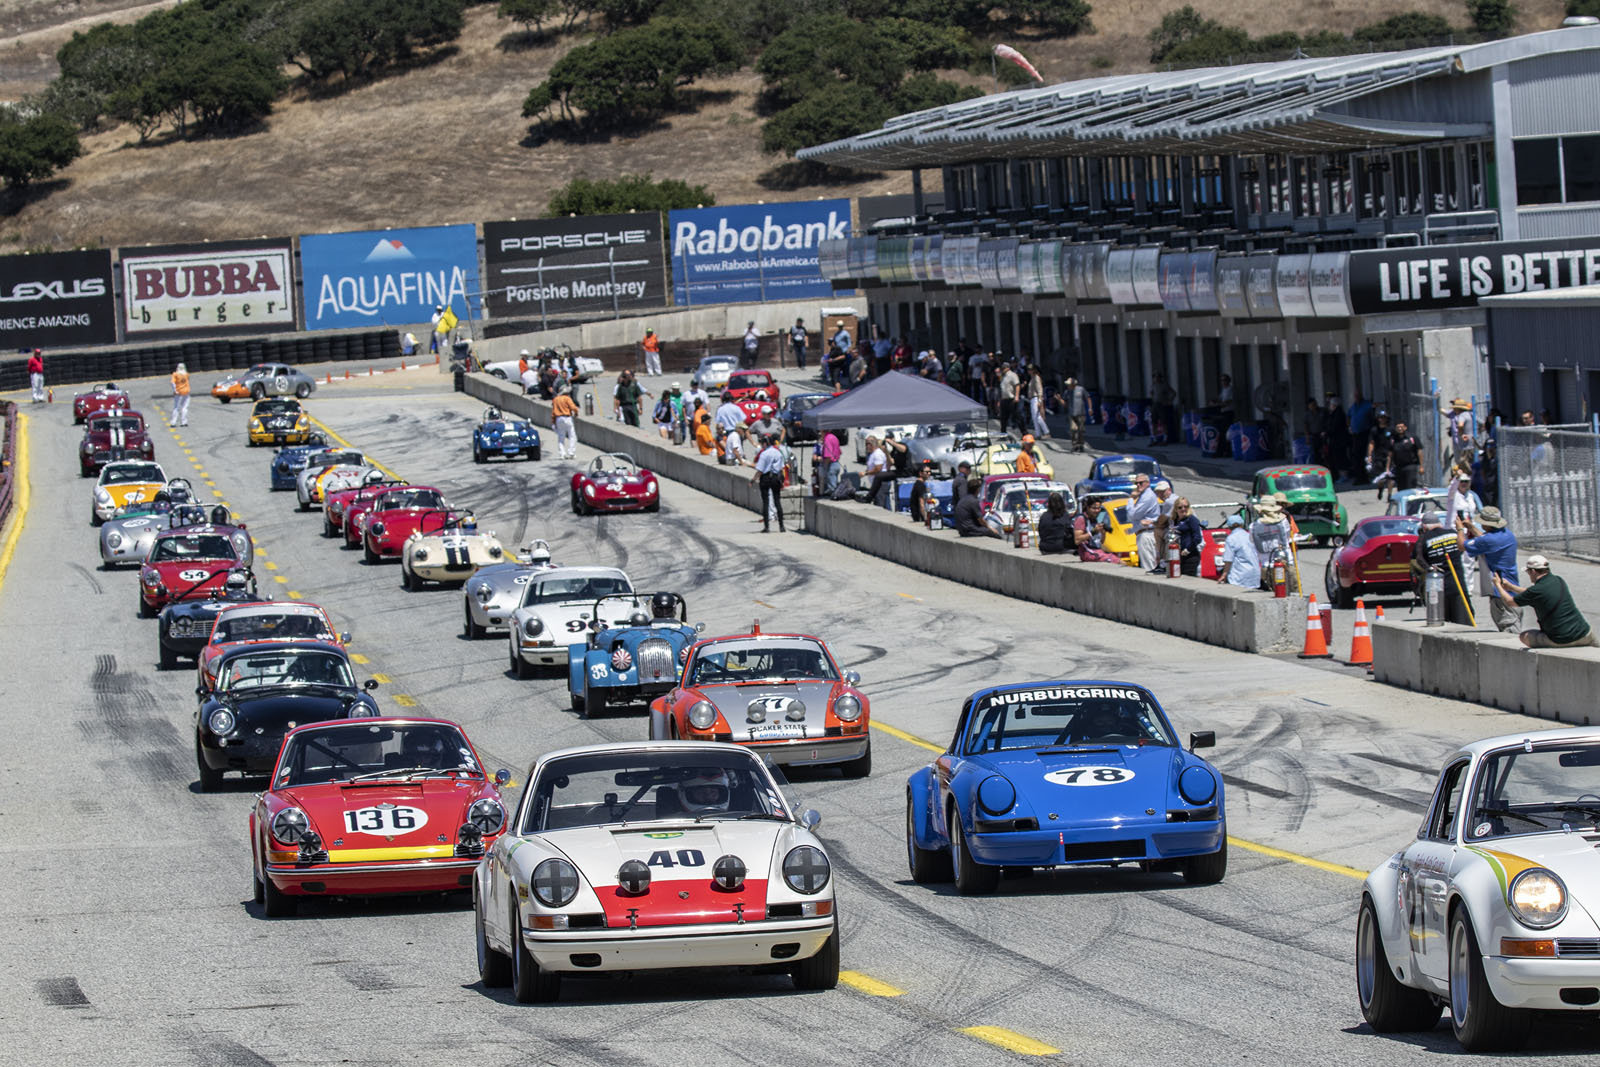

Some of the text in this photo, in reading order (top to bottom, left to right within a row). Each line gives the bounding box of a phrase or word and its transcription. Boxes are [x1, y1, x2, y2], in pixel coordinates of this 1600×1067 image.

[501, 230, 646, 252] PORSCHE
[674, 211, 848, 256] Rabobank
[133, 260, 280, 300] BUBBA
[1379, 249, 1600, 301] LIFE IS BETTE
[316, 266, 467, 320] AQUAFINA
[506, 280, 646, 302] Porsche Monterey
[38, 313, 90, 327] AMAZING
[141, 301, 275, 323] burger
[183, 571, 206, 580] 54
[591, 663, 608, 680] 33
[757, 698, 785, 709] 77
[989, 688, 1140, 707] NURBURGRING
[1056, 768, 1126, 784] 78
[345, 808, 416, 831] 136
[647, 849, 706, 868] 40
